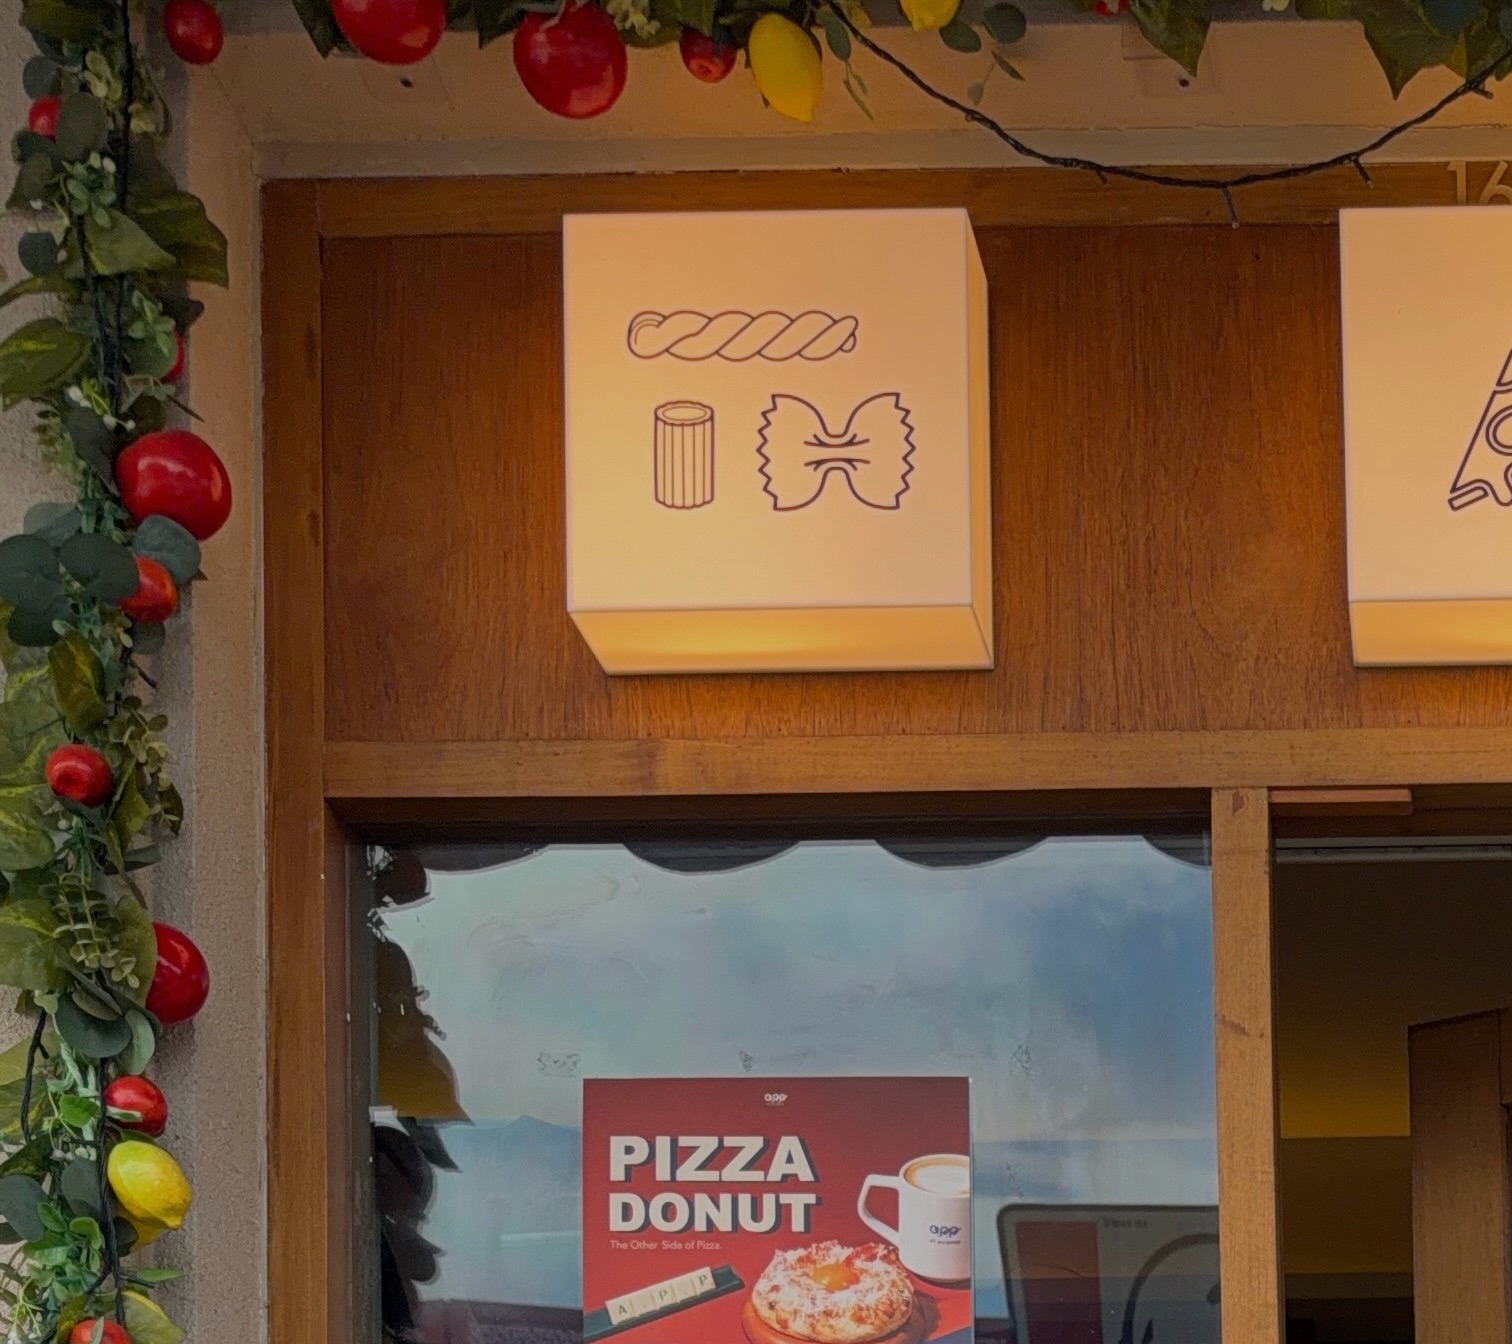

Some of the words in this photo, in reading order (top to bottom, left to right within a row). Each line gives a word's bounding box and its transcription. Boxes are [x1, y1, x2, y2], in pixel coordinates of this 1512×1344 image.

[609, 1135, 818, 1182] PIZZA
[609, 1192, 820, 1233] DONUT
[610, 1240, 628, 1250] The
[630, 1240, 658, 1250] Other
[661, 1240, 682, 1250] Side
[684, 1240, 695, 1250] of
